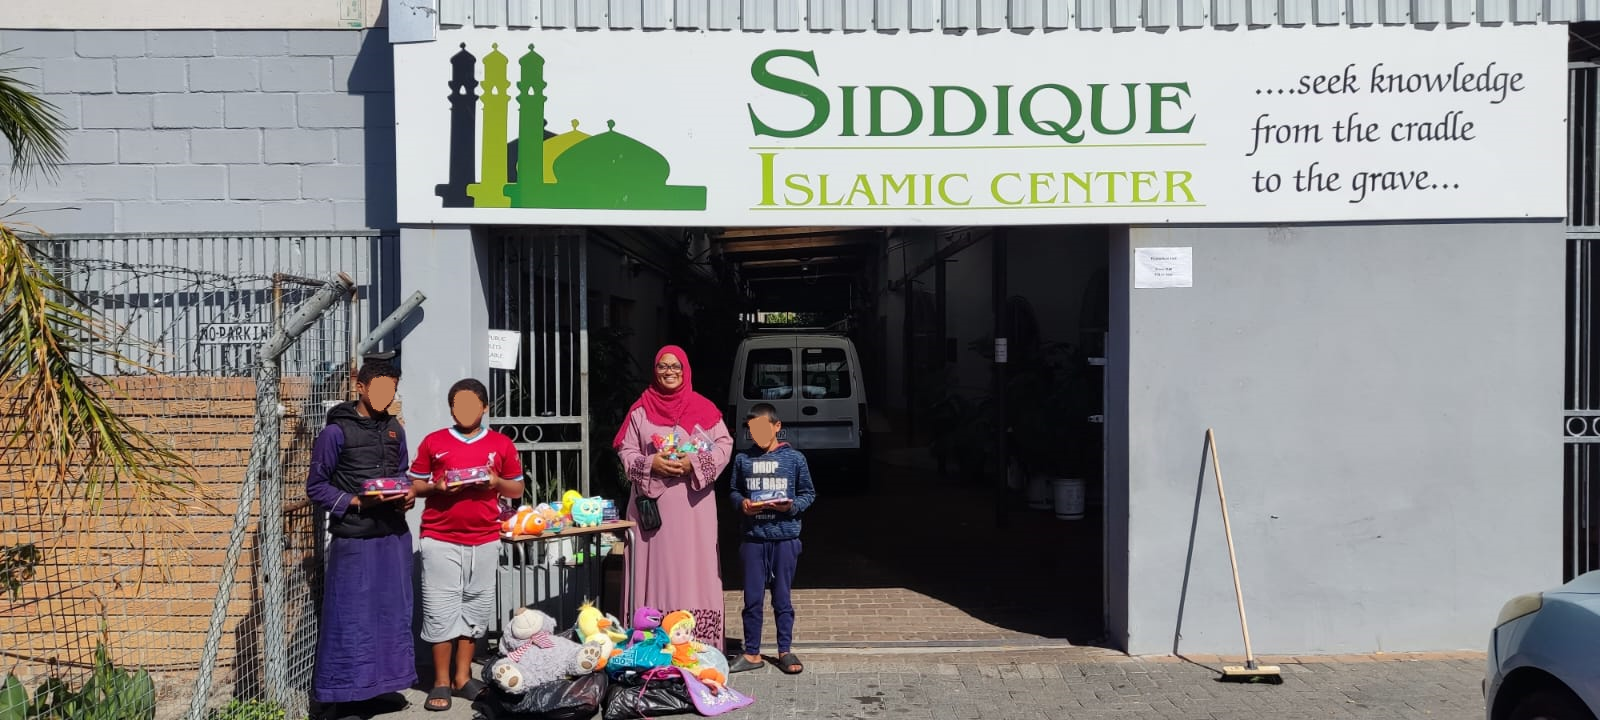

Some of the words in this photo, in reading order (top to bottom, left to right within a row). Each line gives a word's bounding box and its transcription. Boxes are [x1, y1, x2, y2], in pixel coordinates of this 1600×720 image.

[748, 48, 1197, 144] SIDDIQUE
[1370, 62, 1526, 104] knowledge
[1245, 113, 1323, 157] from
[1332, 112, 1380, 143] the
[1391, 110, 1476, 142] cradle
[756, 152, 974, 206] ISLAMIC
[989, 170, 1197, 204] CENTER
[1251, 169, 1282, 193] to
[1292, 161, 1341, 193] the
[745, 478, 761, 491] THE
[762, 478, 788, 491] BASS
[752, 461, 779, 474] DROP
